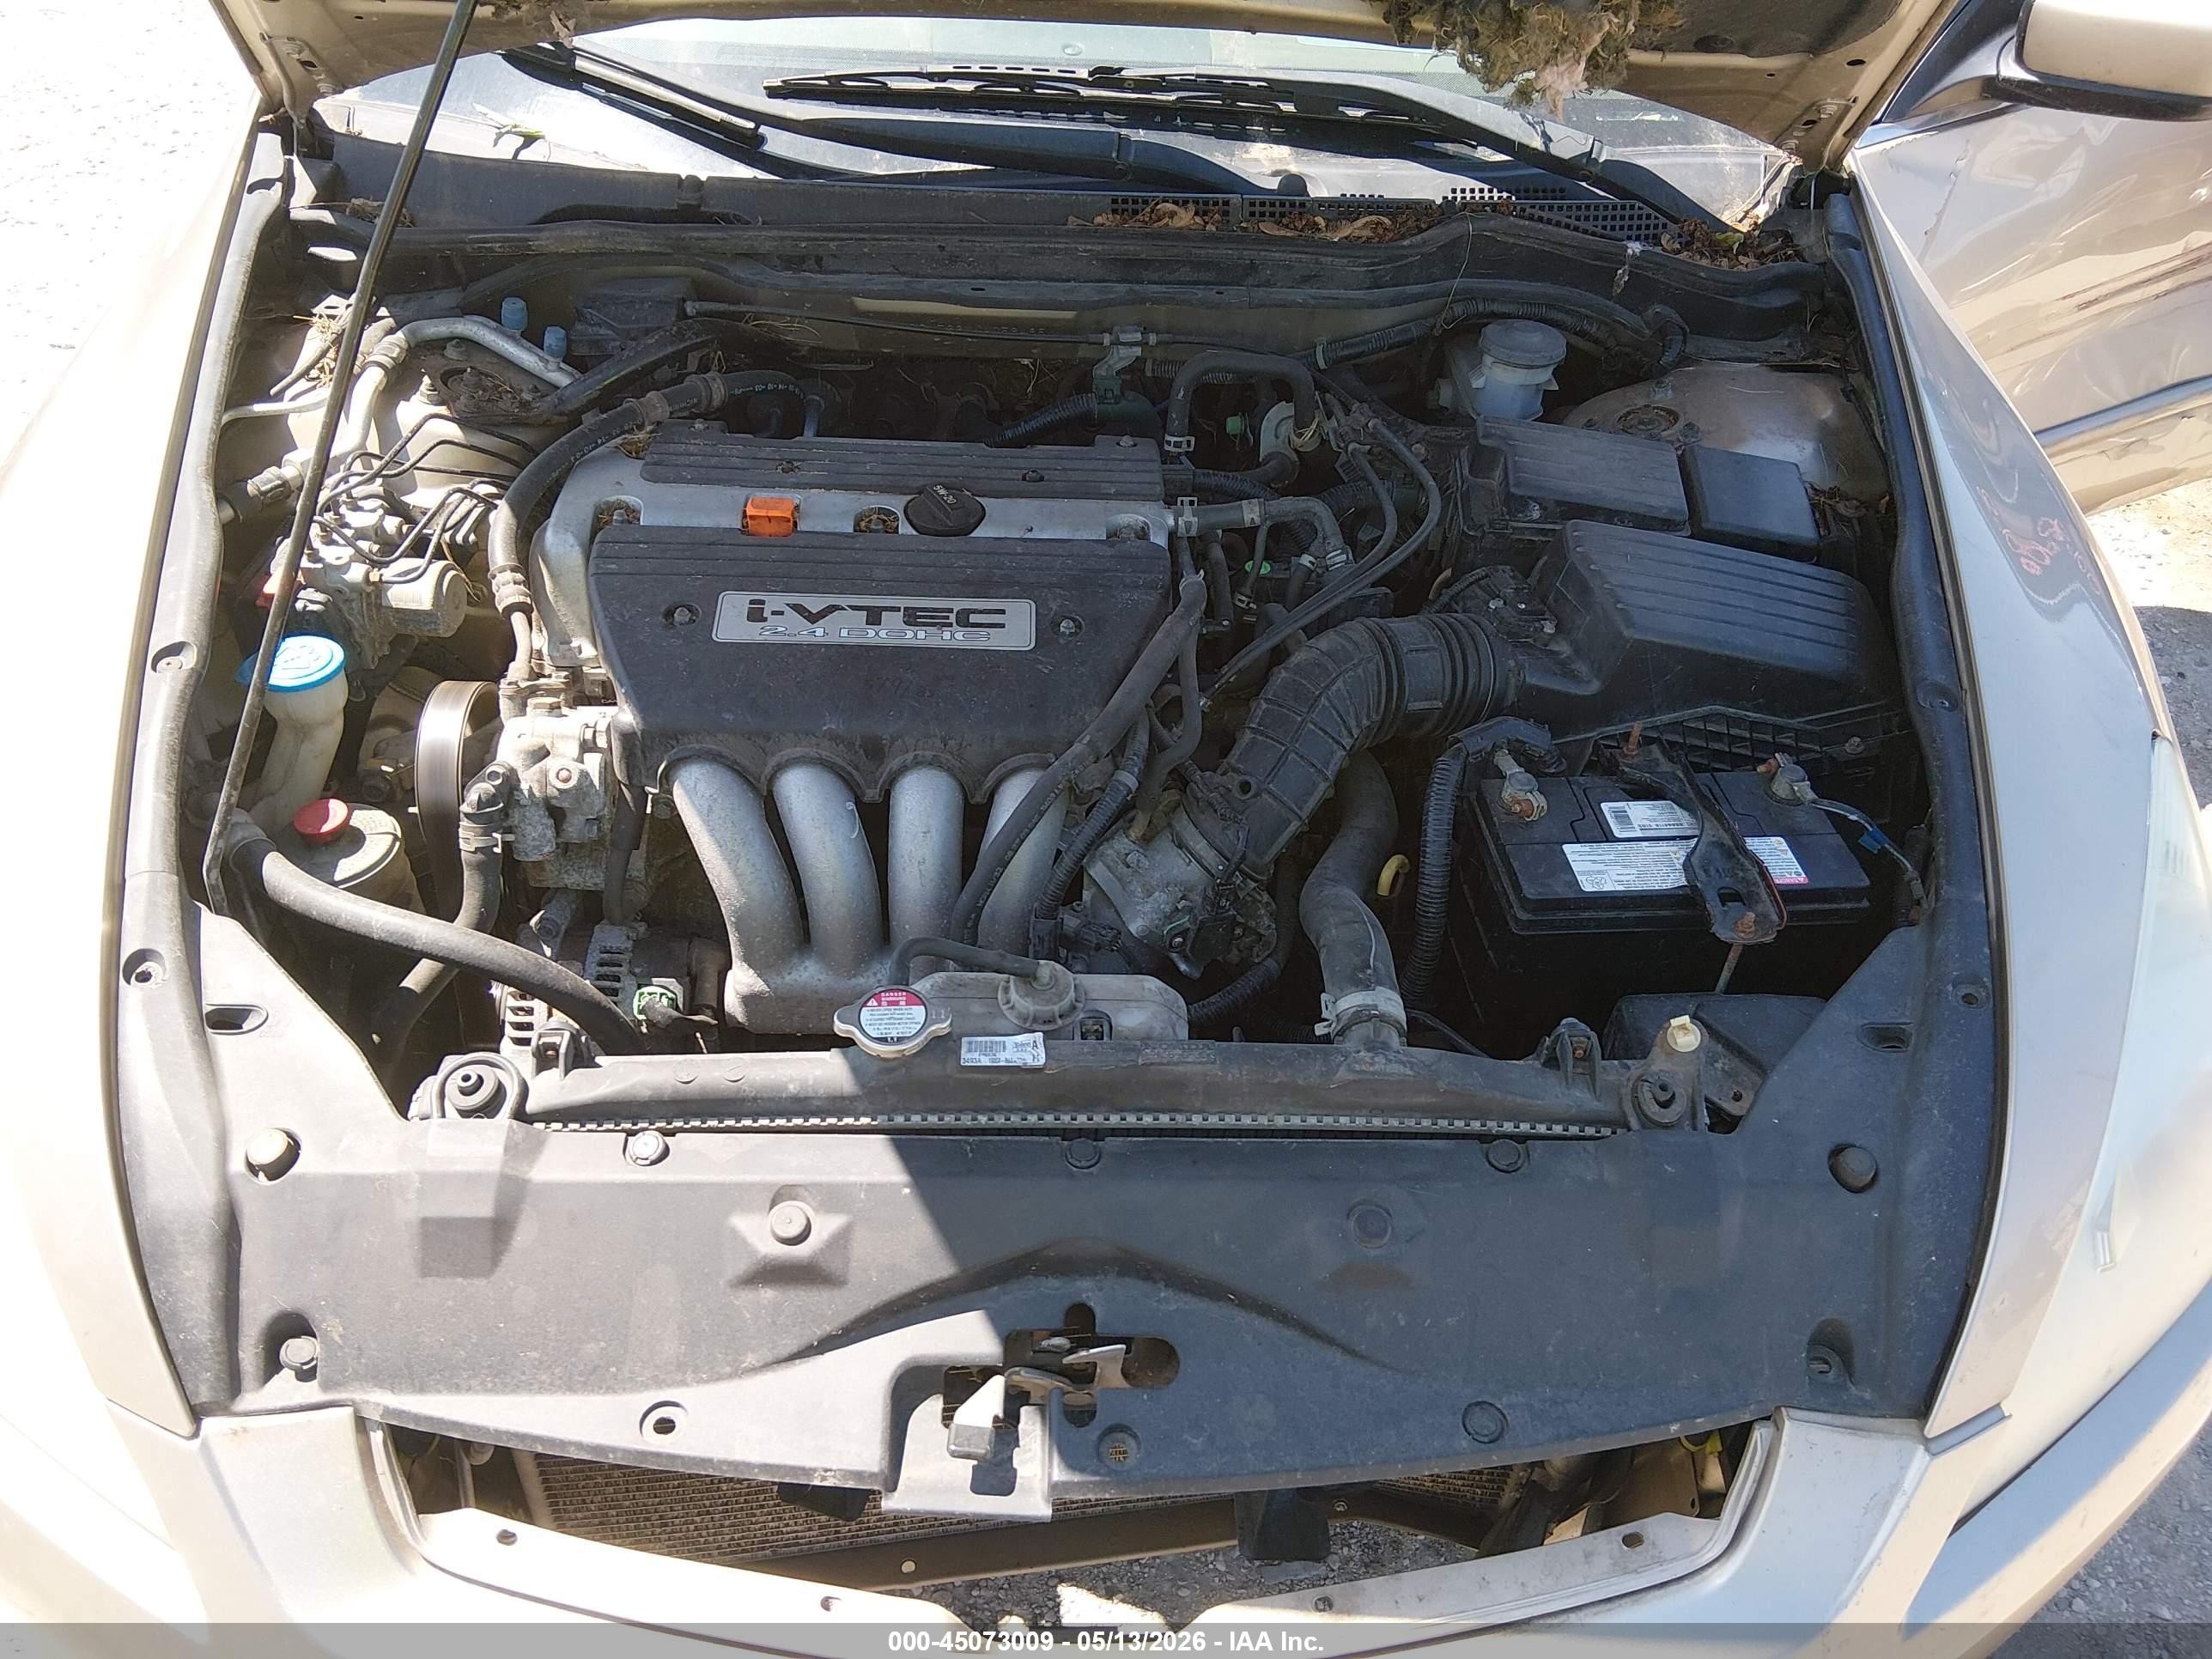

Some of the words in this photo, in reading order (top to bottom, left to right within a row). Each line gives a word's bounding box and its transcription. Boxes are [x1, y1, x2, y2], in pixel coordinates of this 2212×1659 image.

[933, 484, 957, 505] 5W-20
[746, 599, 1006, 629] i-VTEC
[759, 625, 830, 638] 2.4
[838, 627, 991, 642] DOHC
